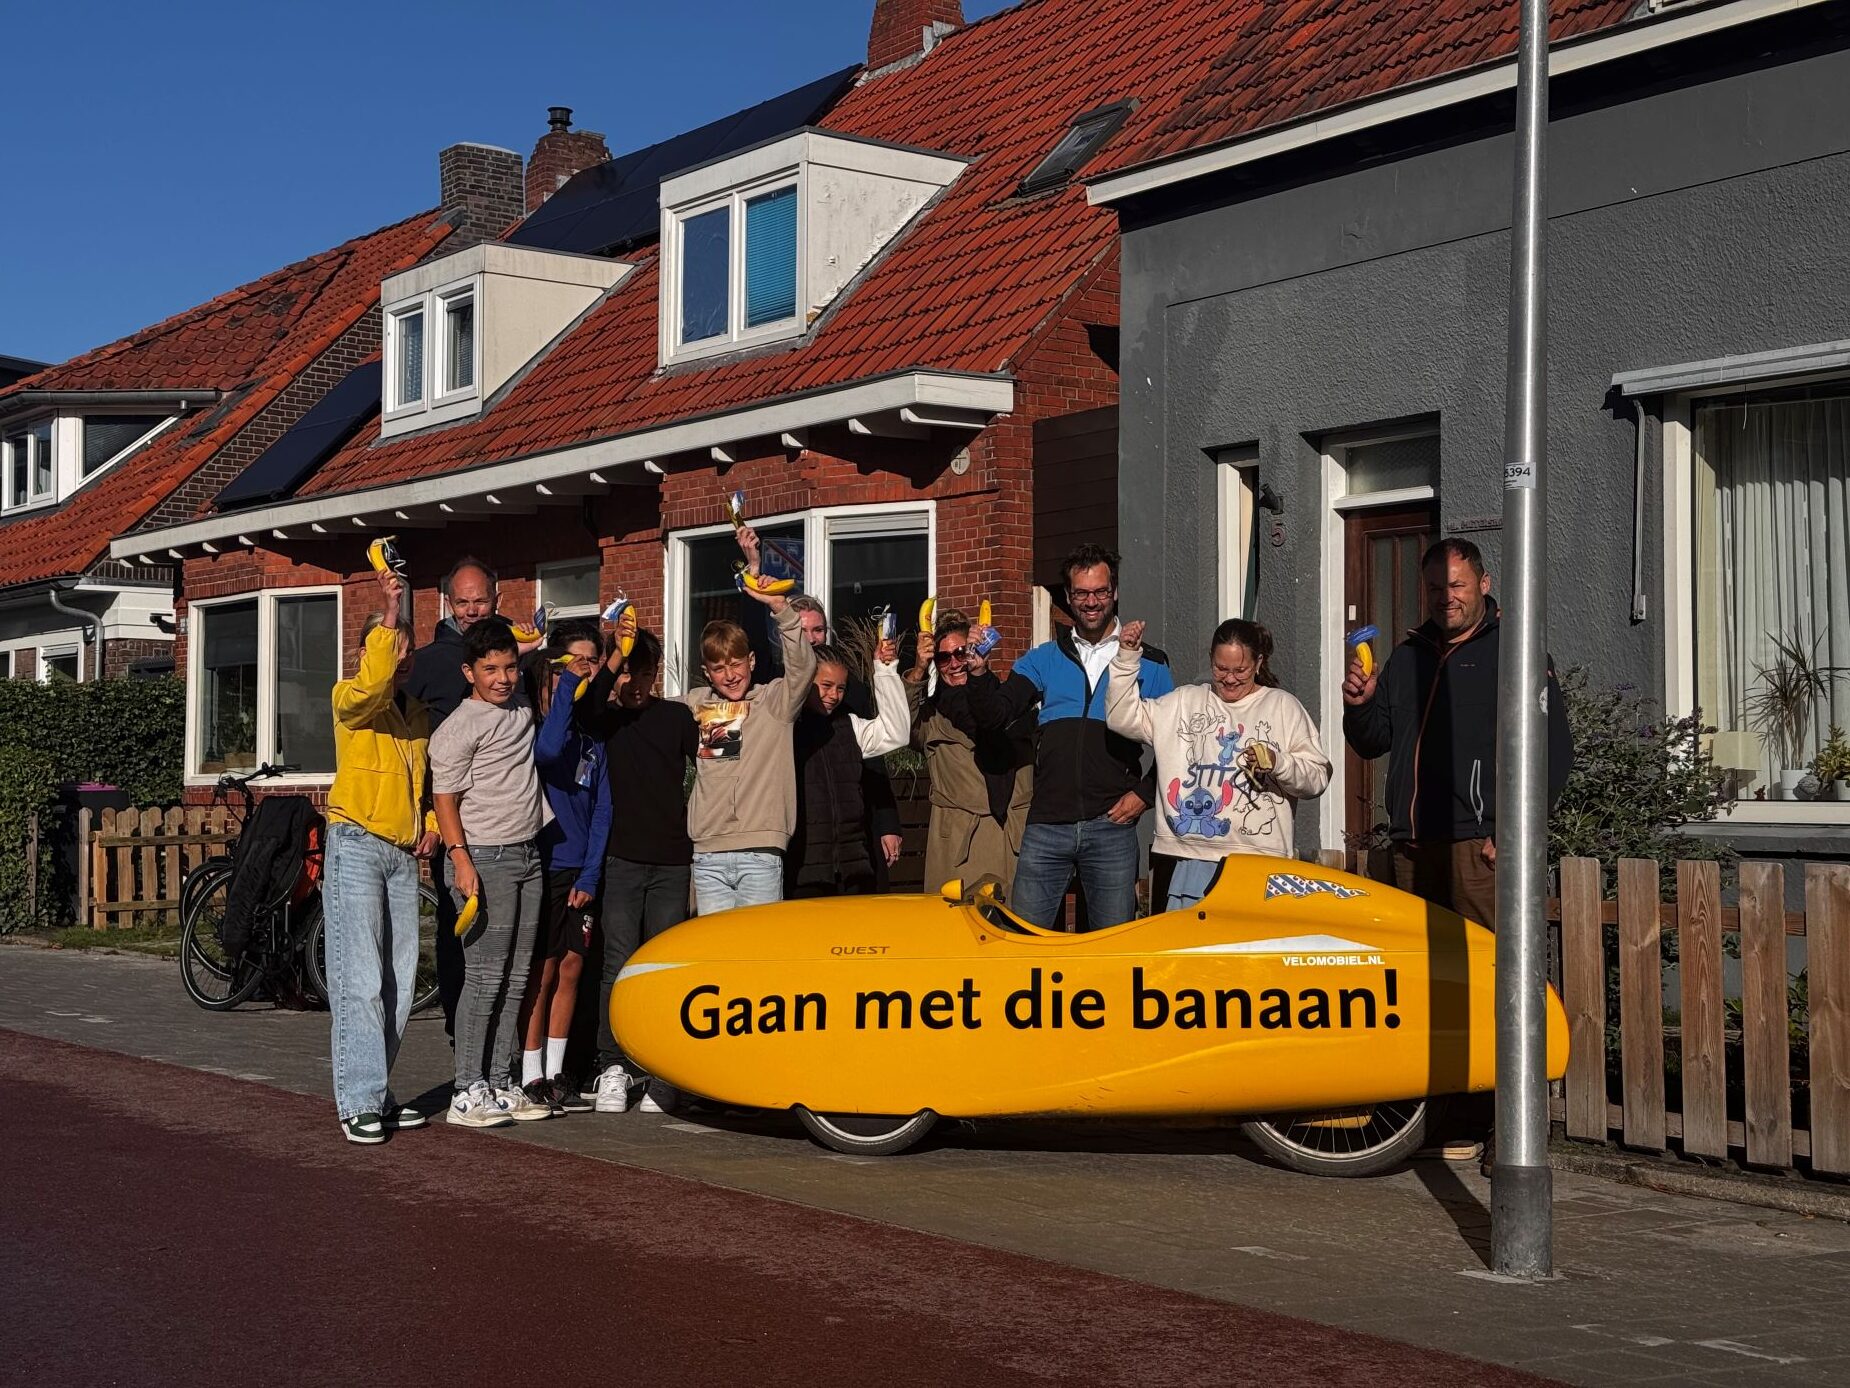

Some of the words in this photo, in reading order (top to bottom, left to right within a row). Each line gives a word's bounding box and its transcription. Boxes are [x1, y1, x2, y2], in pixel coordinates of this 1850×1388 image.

[1271, 521, 1286, 547] 5
[831, 946, 890, 956] QUEST
[1282, 955, 1385, 966] VELOMOBIEL.NL
[680, 985, 827, 1039] Gaan
[855, 978, 982, 1029] met
[1004, 968, 1106, 1029] die
[1131, 967, 1401, 1029] banaan!
